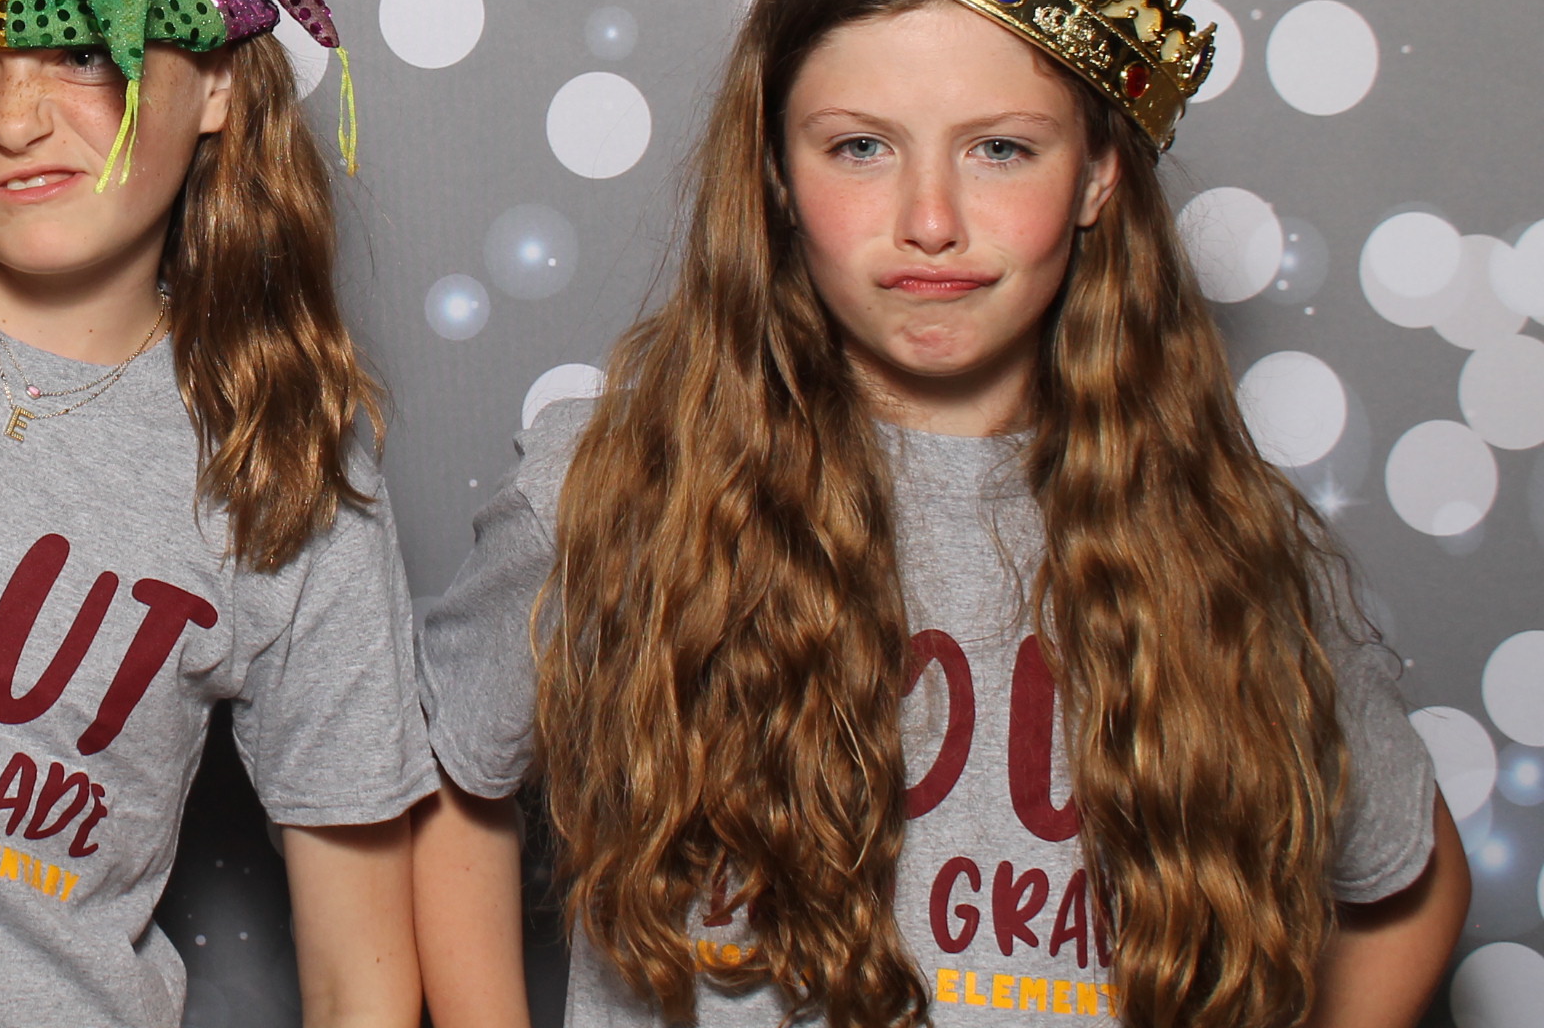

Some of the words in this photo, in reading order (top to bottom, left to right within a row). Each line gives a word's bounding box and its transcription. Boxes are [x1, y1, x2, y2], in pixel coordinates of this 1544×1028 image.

[4, 405, 35, 443] E
[900, 628, 1083, 842] OU
[936, 968, 1120, 1017] ELEMENT
